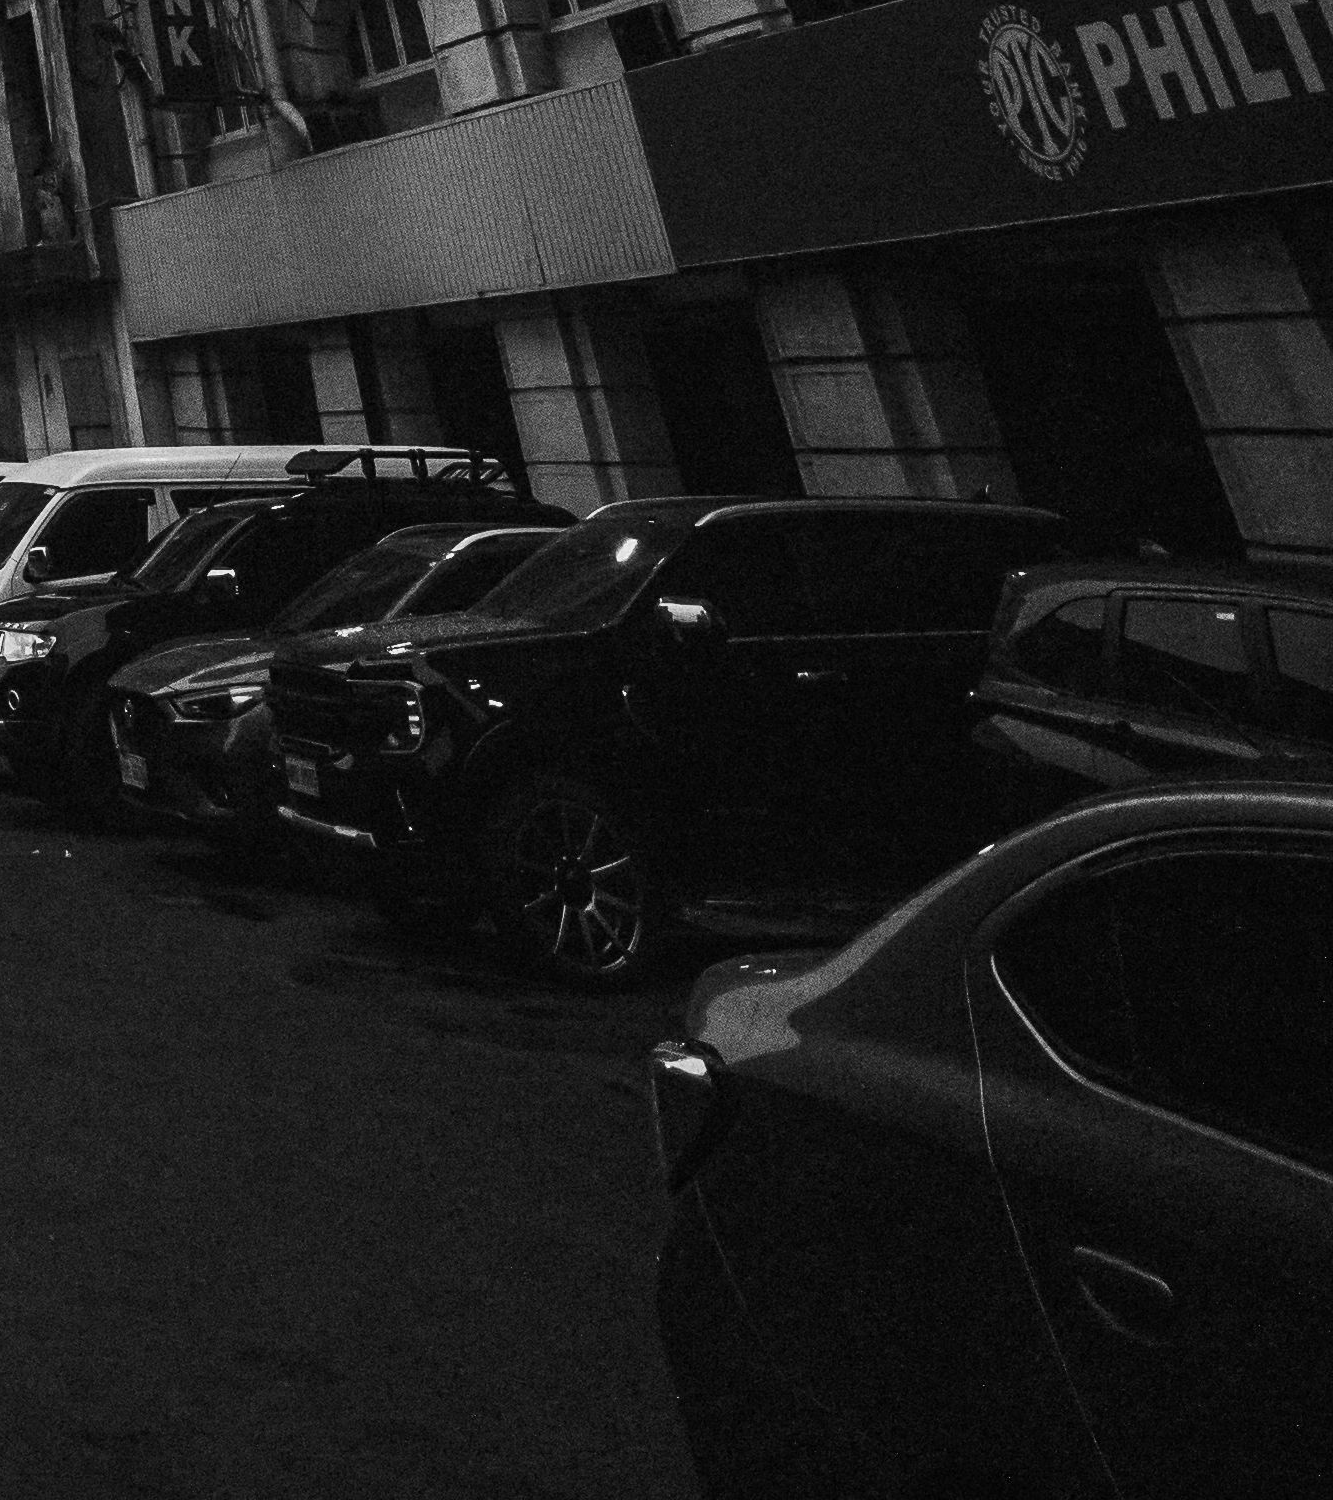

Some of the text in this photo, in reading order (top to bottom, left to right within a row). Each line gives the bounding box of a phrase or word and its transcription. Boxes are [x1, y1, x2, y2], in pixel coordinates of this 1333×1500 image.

[978, 4, 1043, 43] TRUSTED
[978, 61, 1010, 138] YOUR
[1017, 147, 1064, 182] SINCE
